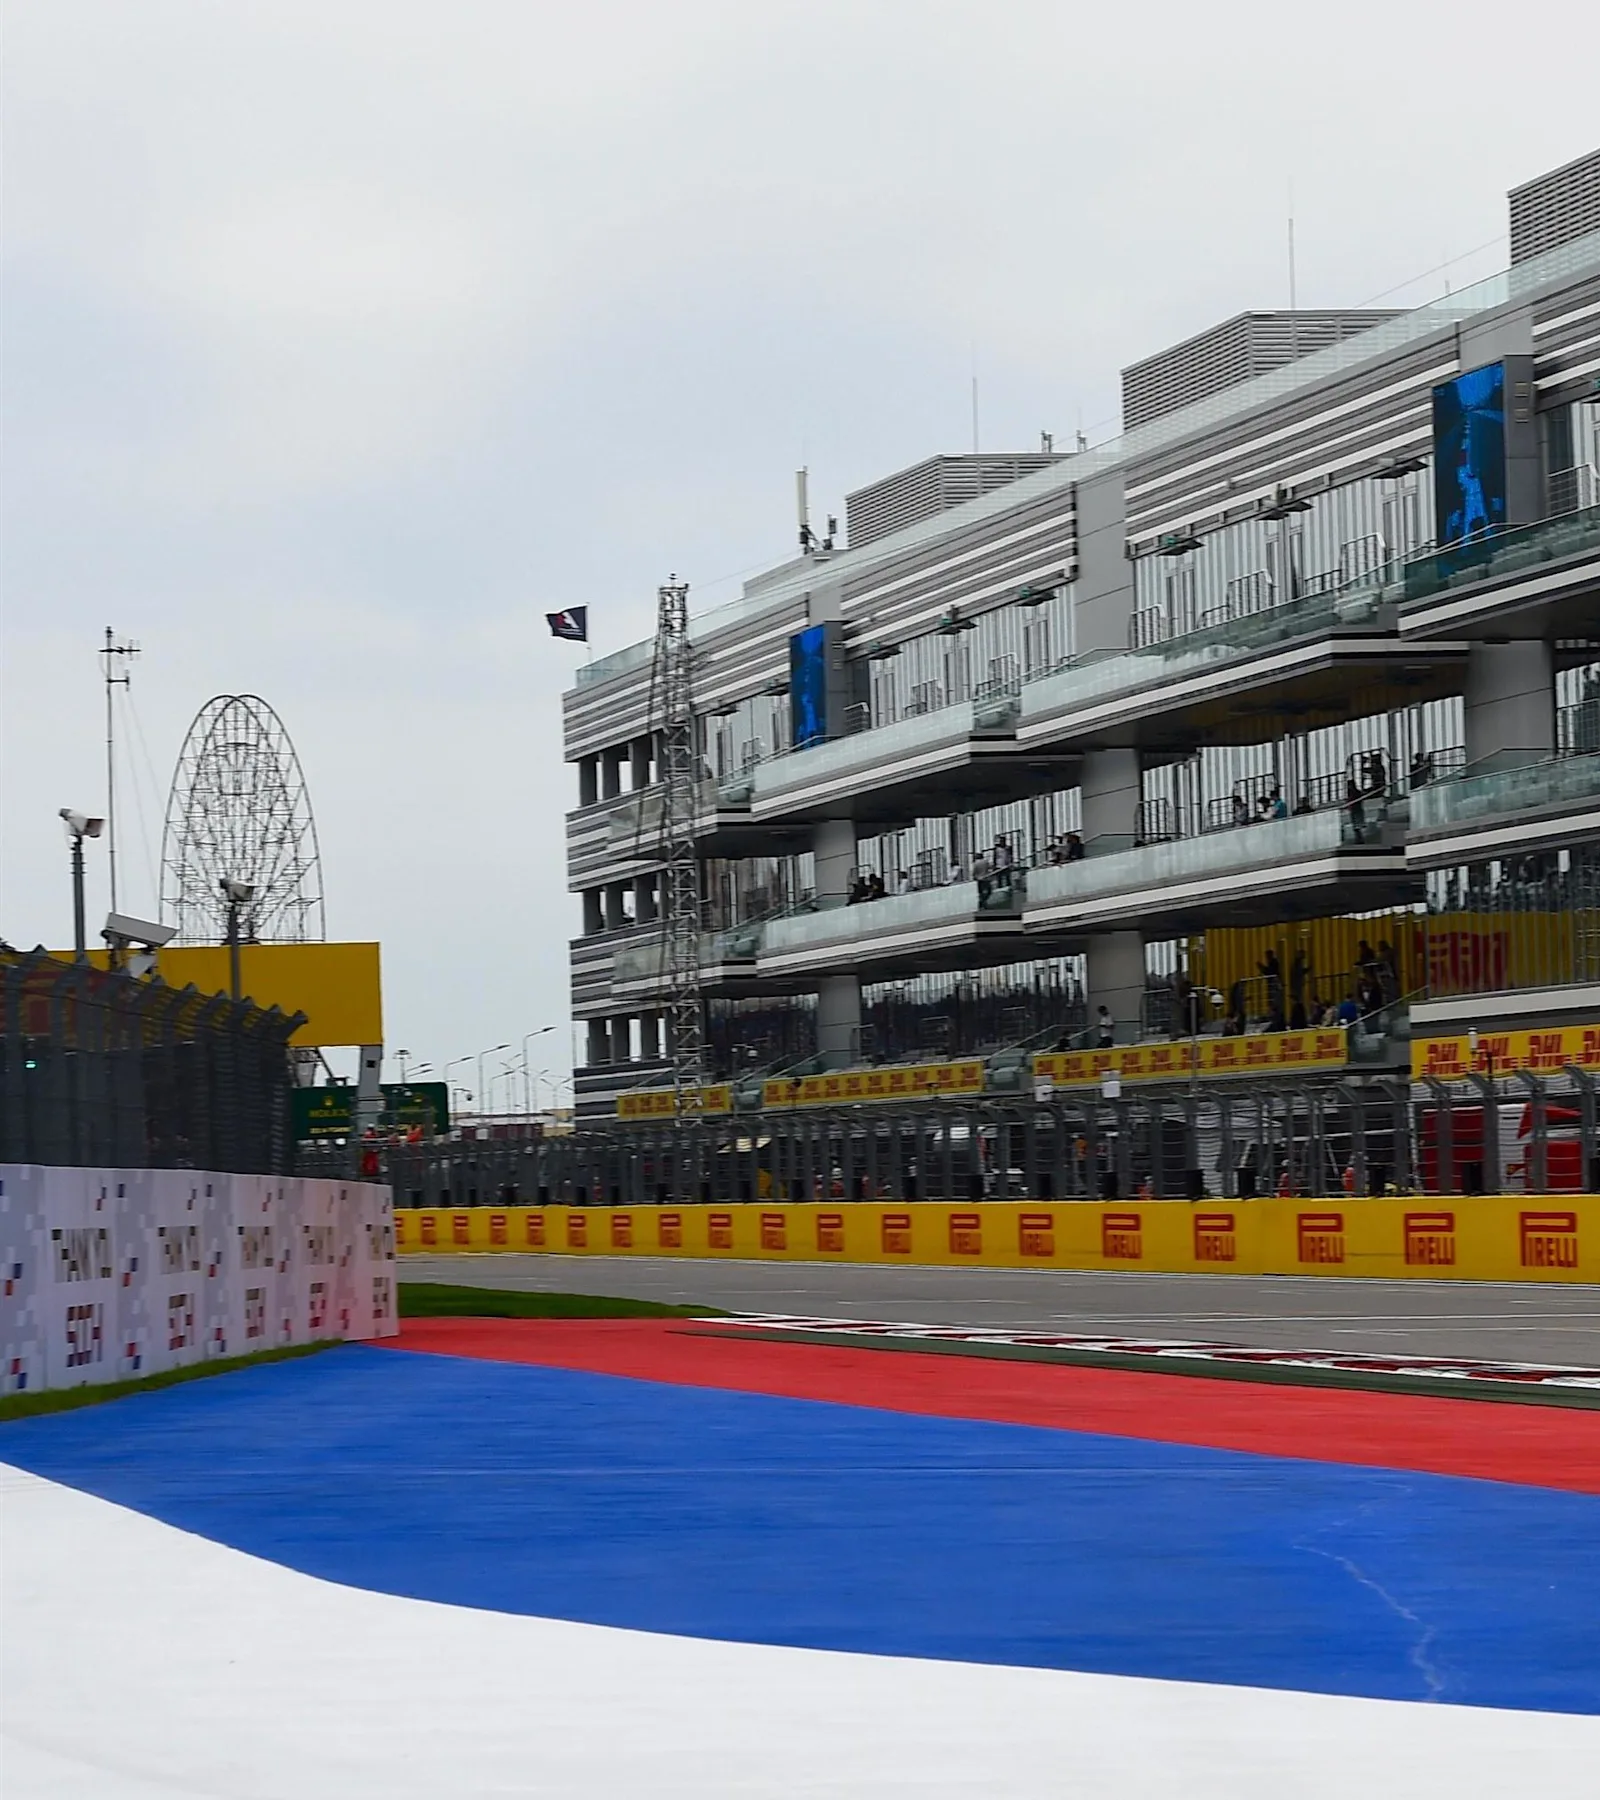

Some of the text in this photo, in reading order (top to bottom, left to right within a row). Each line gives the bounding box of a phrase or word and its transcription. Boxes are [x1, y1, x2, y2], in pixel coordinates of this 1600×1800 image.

[1528, 1034, 1564, 1067] DHL
[1297, 1213, 1343, 1263] PIRELLI
[1404, 1212, 1454, 1265] PIRELLI
[1520, 1211, 1577, 1267] PIRELLI
